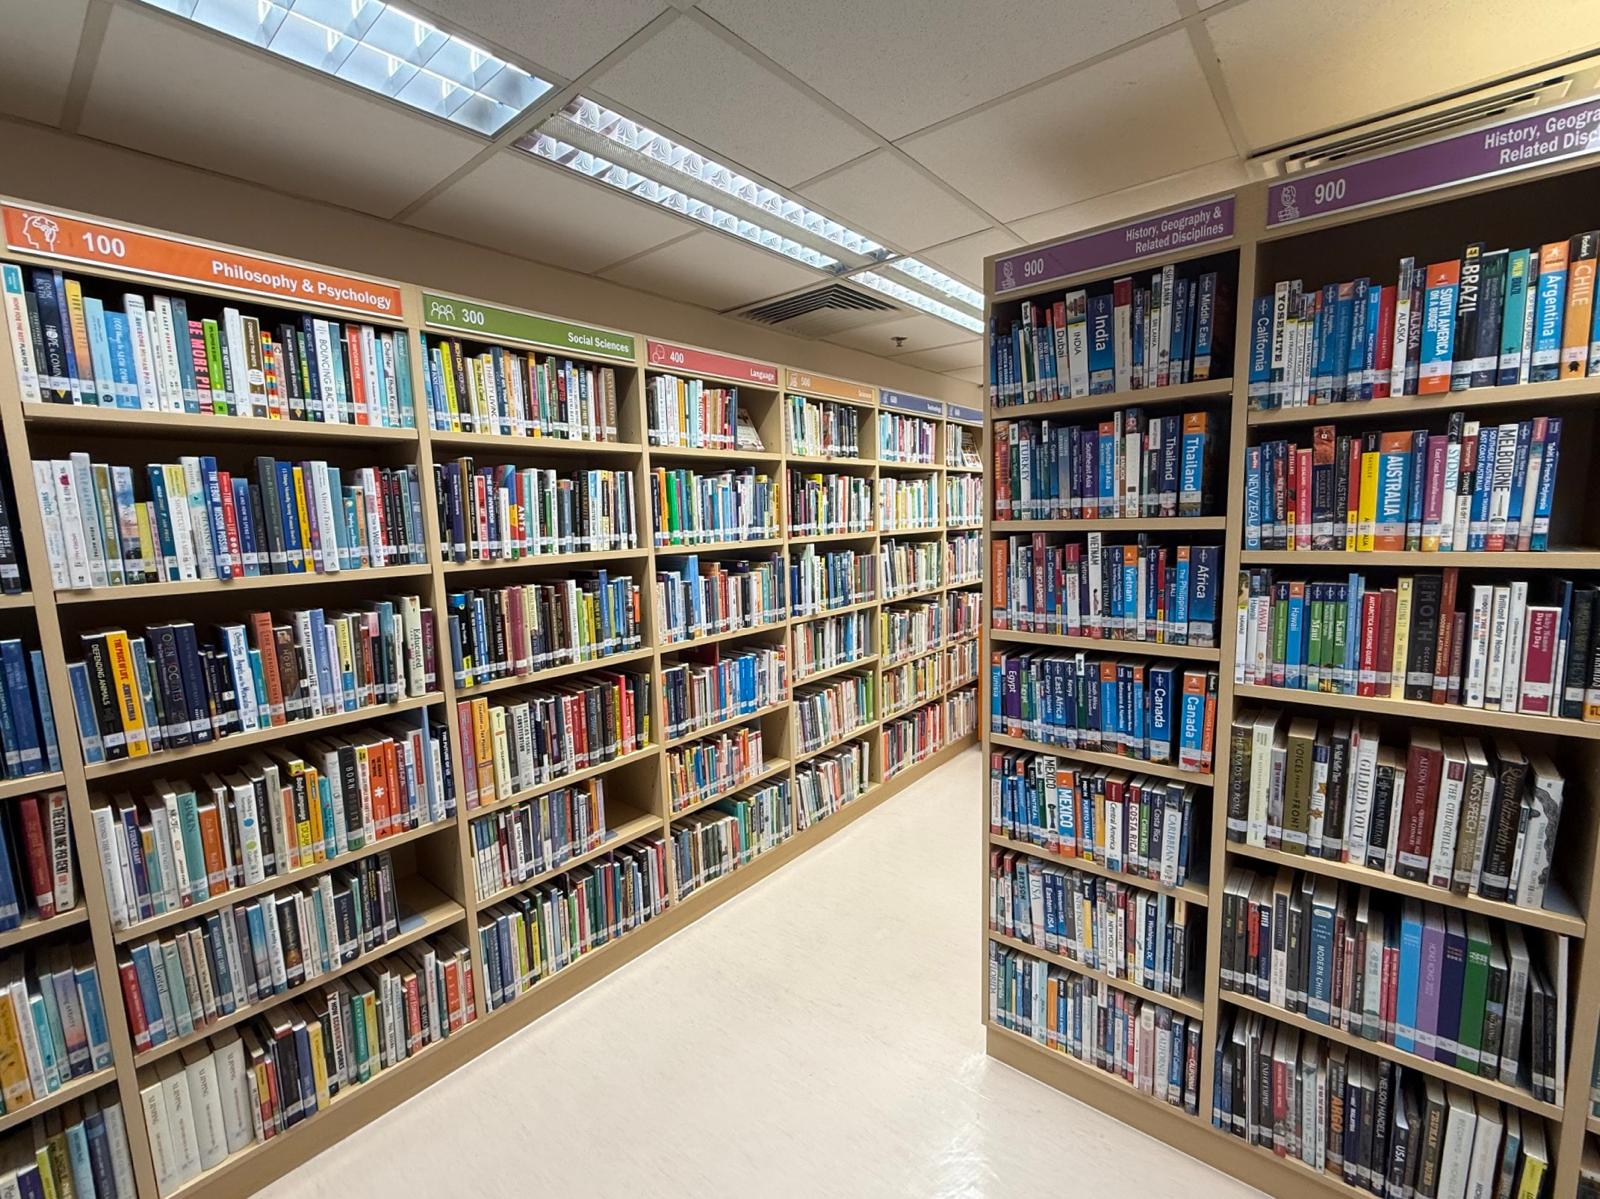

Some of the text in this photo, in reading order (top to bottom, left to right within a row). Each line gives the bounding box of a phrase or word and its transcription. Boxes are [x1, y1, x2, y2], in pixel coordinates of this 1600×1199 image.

[1484, 125, 1540, 149] History,
[1499, 130, 1600, 164] Related Disc
[1314, 178, 1346, 204] 900
[1125, 206, 1222, 242] History, Geography &
[1135, 222, 1224, 254] Related Disciplines
[82, 232, 126, 258] 100
[212, 259, 392, 310] Philosophy & Psychology
[1024, 258, 1044, 277] 900
[1162, 269, 1172, 307] SRI LANKA
[1459, 264, 1480, 317] BRAZIL
[1571, 265, 1591, 307] CHILE
[461, 308, 485, 325] 300
[1198, 294, 1210, 347] Middle East
[1435, 288, 1453, 355] SOUTH AMERICA
[1542, 275, 1562, 337] Argentina
[567, 332, 630, 353] Social Sciences
[1056, 330, 1067, 358] Dubai
[1073, 331, 1081, 355] INDIA
[1095, 315, 1109, 351] India
[1255, 317, 1270, 371] California
[1275, 295, 1286, 362] YOSEMITE
[1397, 312, 1408, 344] ALASKA
[1408, 311, 1421, 349] ALASKA
[45, 325, 62, 377] HOPE COMIN
[189, 320, 213, 415] BE MORE PIATE
[383, 341, 393, 368] Chatter
[669, 351, 685, 364] 400
[319, 339, 334, 402] BOUNCING BAC
[749, 368, 775, 381] Language
[1021, 442, 1030, 481] TURKEY
[1165, 436, 1177, 480] Thailand
[1184, 437, 1199, 491] Thailand
[1445, 449, 1460, 492] SYDNEY
[1478, 444, 1486, 462] COAST
[1484, 430, 1496, 492] SOUTHEAST AUSTRALIA
[1493, 429, 1517, 492] MELBOURNE
[1085, 474, 1093, 488] Asia
[1384, 455, 1404, 516] AUSTRALIA
[1462, 471, 1470, 494] SYDNEY
[1476, 463, 1484, 491] AUSTRALIA
[41, 491, 54, 515] switch
[208, 471, 229, 555] TIM TEBOW MISSION POSSIBL
[224, 492, 233, 506] TIME
[1248, 474, 1258, 546] NEW ZEALAND
[1276, 477, 1285, 520] NEW ZEALAND
[1337, 477, 1346, 518] AUSTRALIA
[227, 523, 237, 536] LIFE
[1090, 535, 1099, 566] VIETNAM
[1126, 568, 1135, 602] Vietnam
[1178, 580, 1187, 620] Philippines
[1197, 565, 1209, 599] Africa
[1290, 607, 1299, 631] Hawaii
[1367, 596, 1375, 626] ANTARCTICA
[1494, 594, 1507, 662] Brilliant Baby Names
[1311, 619, 1321, 641] Maui
[1542, 613, 1553, 652] Baby Names
[282, 649, 291, 673] HOPE
[413, 628, 423, 669] Educated
[92, 643, 110, 706] DEFENDING ANIMALS
[1008, 670, 1017, 693] Egypt
[1055, 676, 1063, 694] East
[1154, 688, 1166, 728] Canada
[1185, 697, 1199, 738] Canada
[345, 766, 355, 790] BORN
[1045, 759, 1056, 789] MEXICO
[1234, 750, 1243, 776] ROADS
[1415, 756, 1428, 804] ALISON WEIR
[296, 777, 306, 821] Body Language
[1233, 780, 1242, 790] TO
[1352, 760, 1371, 840] GILDED YOUT
[1501, 767, 1521, 798] Queen
[1059, 789, 1073, 828] MEXICO
[1231, 792, 1240, 815] ROME
[1373, 791, 1387, 845] ROMAN BRITAIN
[1440, 782, 1458, 857] THE CHURCHILLS
[1465, 772, 1484, 833] KING'S SPEECH
[1109, 825, 1117, 850] America
[1129, 805, 1137, 852] COSTA RICA
[1153, 808, 1161, 842] Costa Rica
[1166, 813, 1177, 861] CARIBBEAN
[1495, 800, 1520, 845] Elizabeth
[1018, 871, 1026, 900] BRYSON
[1031, 879, 1041, 900] USA
[1045, 887, 1053, 912] Eastern
[1261, 911, 1269, 927] SAVED
[1316, 945, 1325, 976] MODERN
[153, 963, 167, 995] Rooted
[1331, 1095, 1343, 1133] ARGO
[1376, 1077, 1387, 1138] NELSON MANDELA
[1428, 1110, 1440, 1148] TRUMAN
[1395, 1144, 1406, 1162] USA
